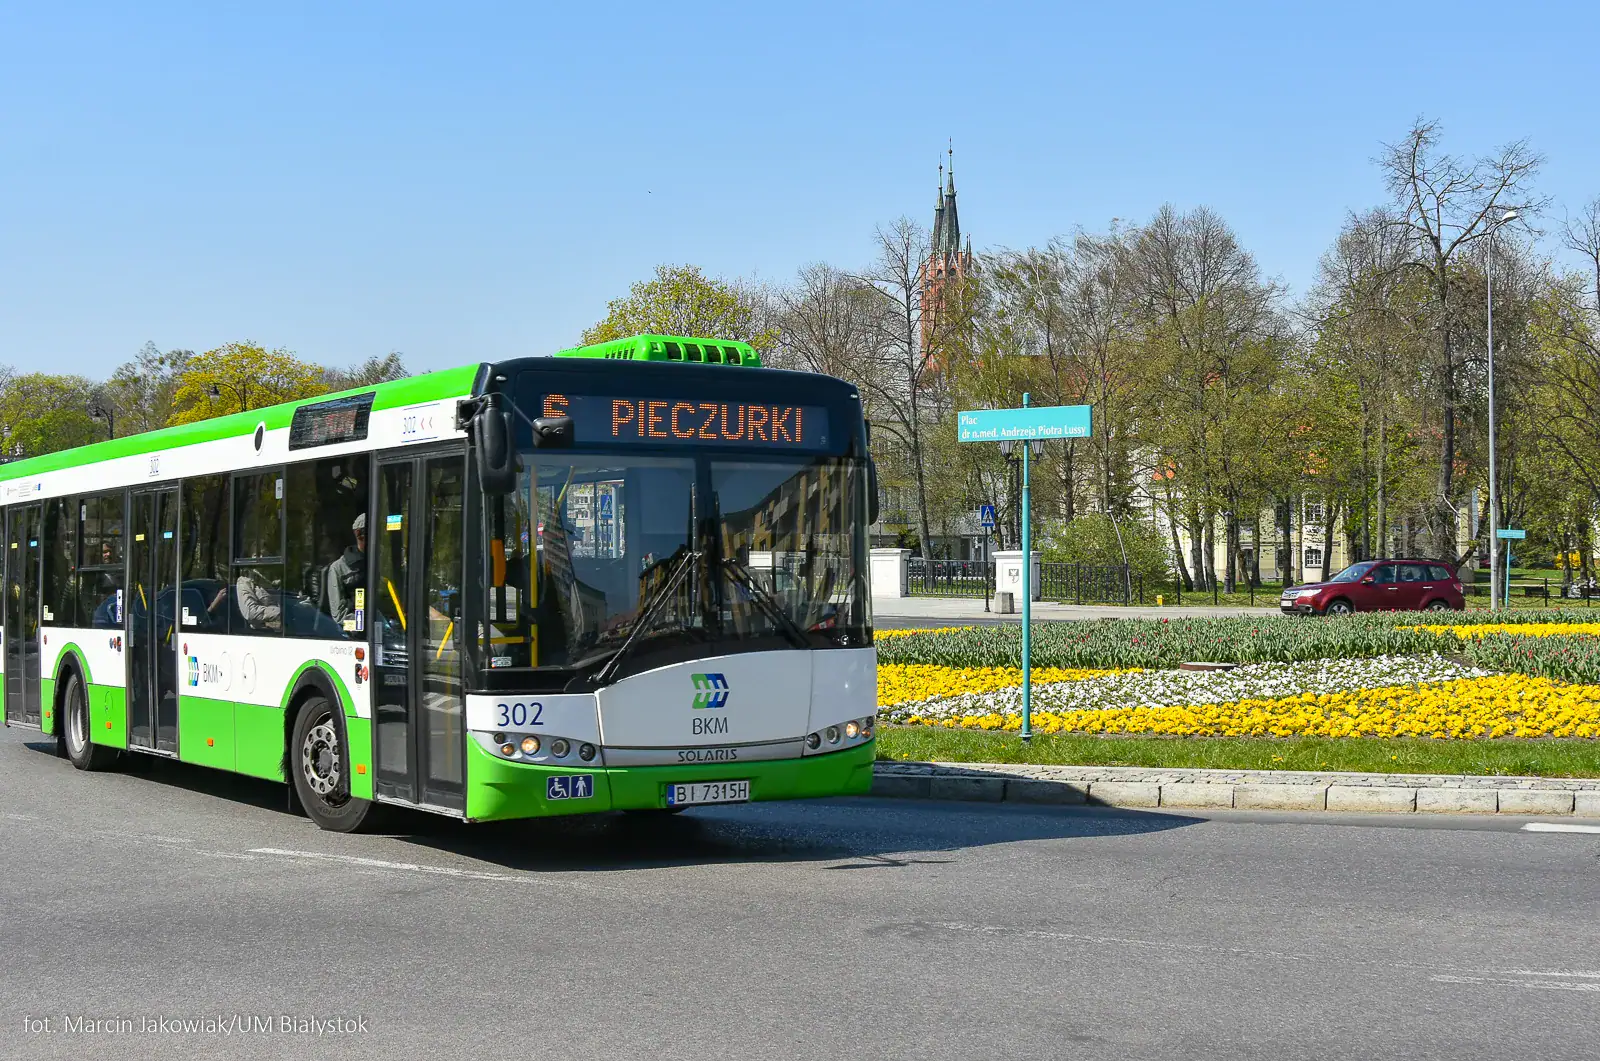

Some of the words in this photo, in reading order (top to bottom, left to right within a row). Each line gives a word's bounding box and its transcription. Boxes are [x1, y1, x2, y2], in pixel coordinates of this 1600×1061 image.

[612, 399, 803, 442] PIECZURKI
[961, 415, 978, 426] Plac
[961, 428, 971, 439] dr
[1000, 425, 1036, 438] Andrzeja
[1038, 424, 1062, 436] Piotra
[1064, 424, 1087, 437] Lussy
[203, 663, 218, 683] BKM
[497, 702, 544, 727] 302
[692, 717, 729, 735] BKM
[677, 748, 738, 763] SOLARIS
[677, 785, 695, 803] BI
[702, 782, 748, 801] 7315H
